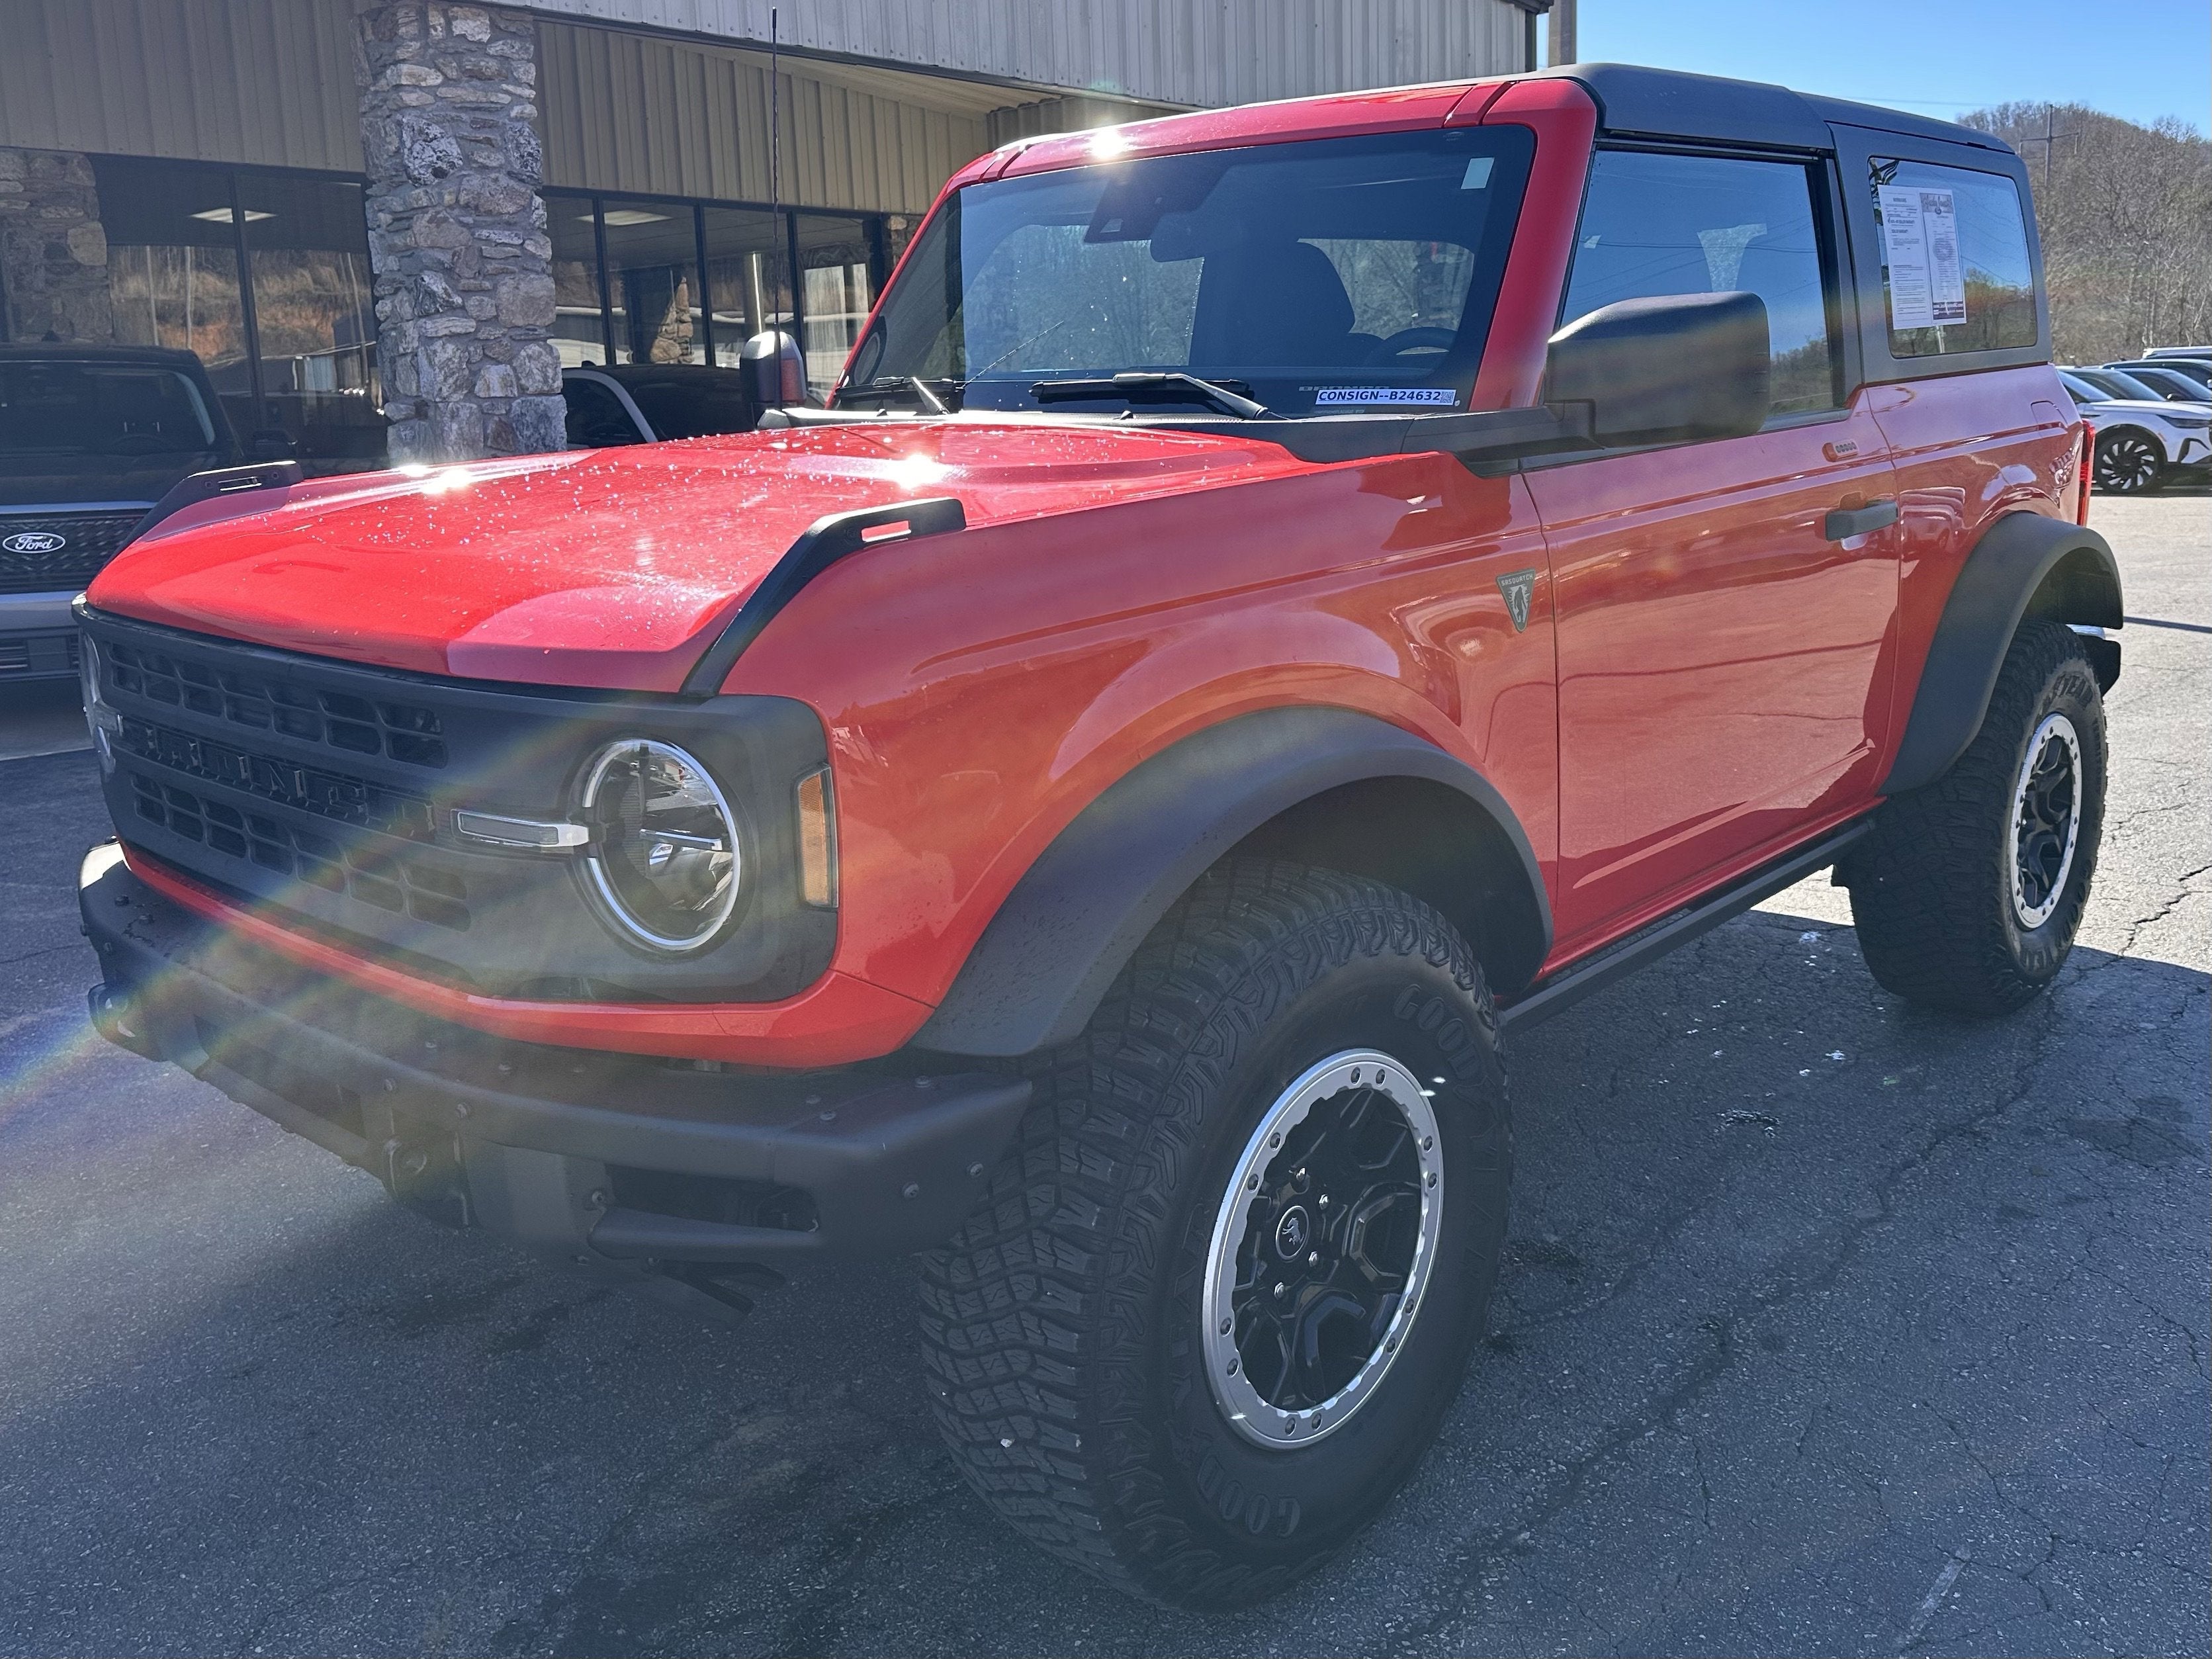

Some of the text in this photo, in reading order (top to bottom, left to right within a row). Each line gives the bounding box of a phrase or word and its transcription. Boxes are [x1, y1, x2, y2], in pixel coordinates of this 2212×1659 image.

[1318, 391, 1441, 401] CONSIGN--B24632
[15, 535, 54, 551] Ford
[1501, 574, 1534, 586] SASQUATCH
